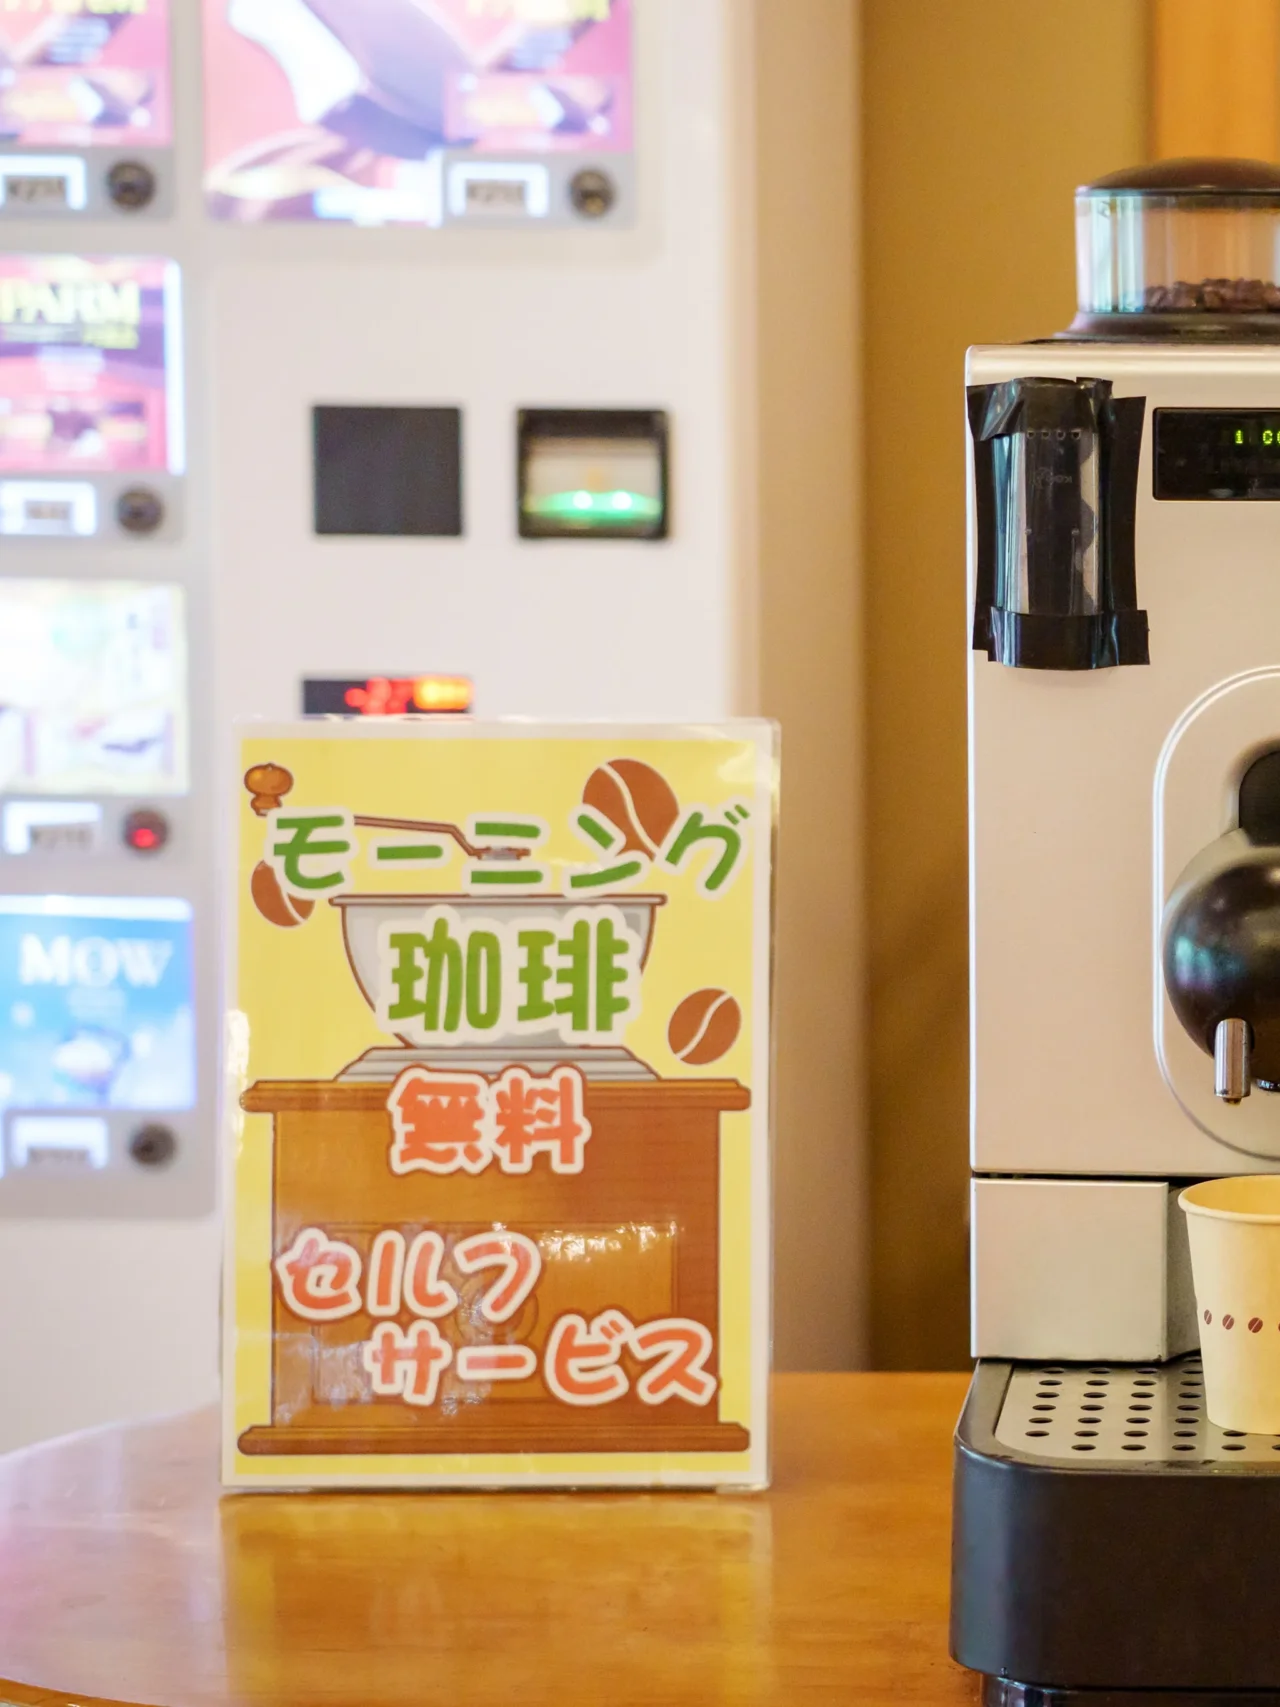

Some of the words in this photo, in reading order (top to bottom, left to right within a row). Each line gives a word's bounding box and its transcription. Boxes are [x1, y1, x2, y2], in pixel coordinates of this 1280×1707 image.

[1234, 430, 1244, 445] 1
[272, 803, 750, 892] モーニング
[20, 933, 173, 987] MOW
[387, 916, 631, 1032] 珈琲
[394, 1071, 587, 1173] 無料
[284, 1235, 534, 1316] セルフ
[367, 1316, 712, 1401] サービス
